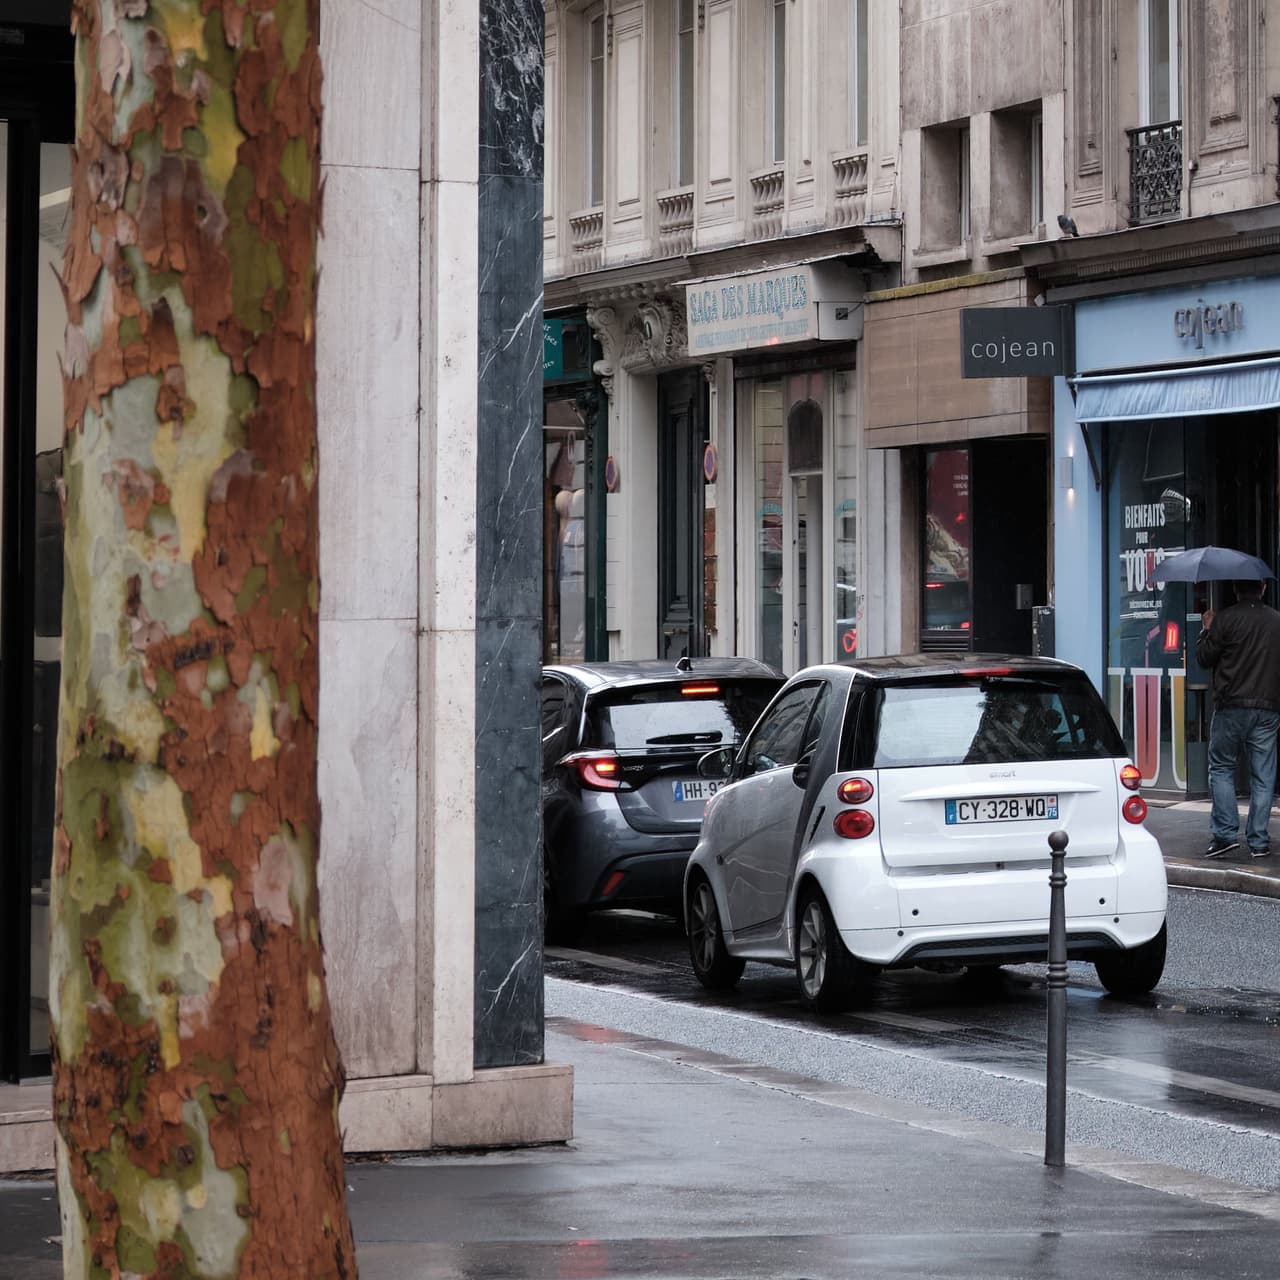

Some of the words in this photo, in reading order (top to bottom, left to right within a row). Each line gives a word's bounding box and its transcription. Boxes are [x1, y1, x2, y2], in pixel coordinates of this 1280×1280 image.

[689, 287, 720, 326] SAGA
[721, 284, 744, 321] DES
[745, 274, 808, 321] MARQUES
[1174, 298, 1244, 351] cojean
[971, 336, 1056, 363] cojean
[1125, 503, 1166, 529] BIENFAITS
[1136, 531, 1148, 544] POUR
[959, 799, 1046, 821] CY-328-WQ
